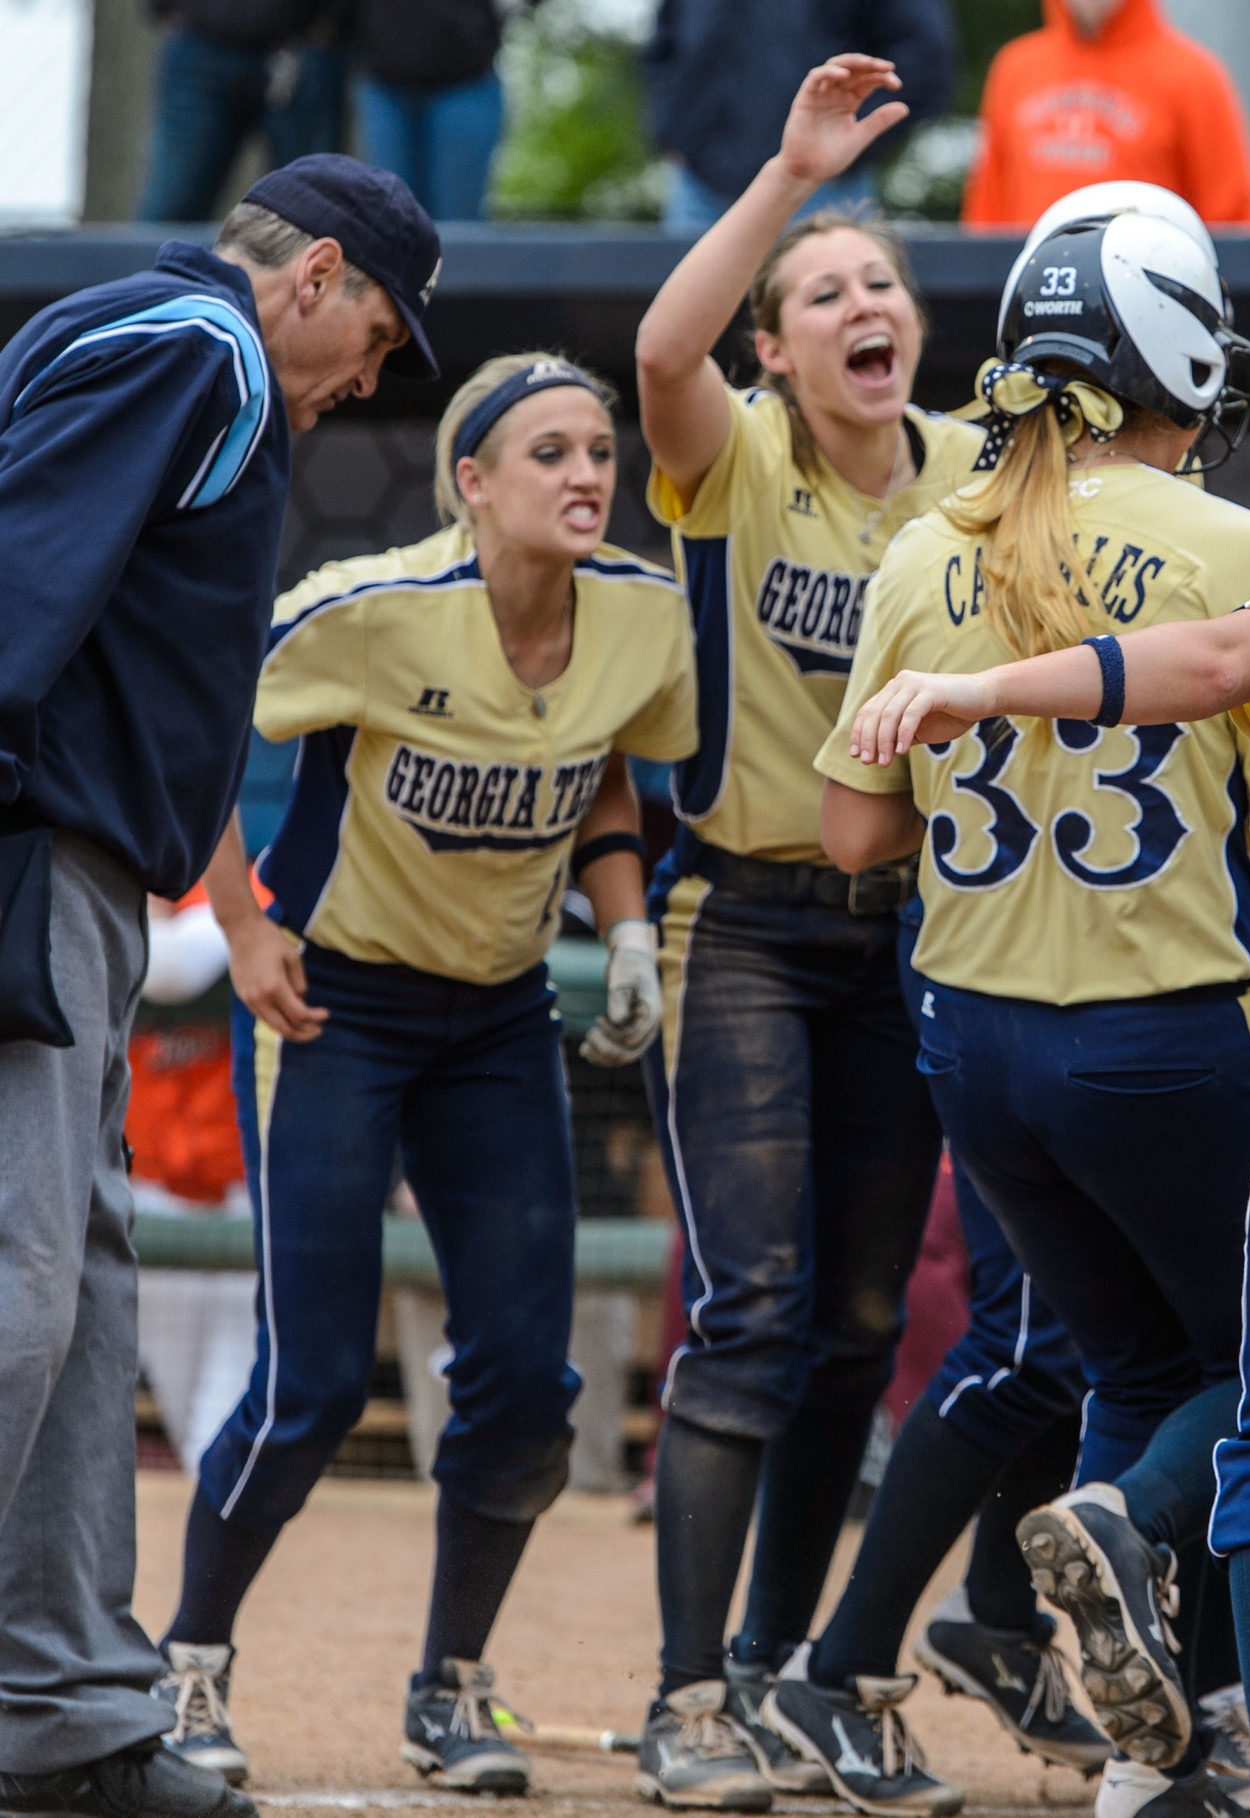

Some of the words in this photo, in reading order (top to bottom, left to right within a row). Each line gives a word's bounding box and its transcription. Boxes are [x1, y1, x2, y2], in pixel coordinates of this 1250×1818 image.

[1034, 300, 1083, 316] WORTH
[1040, 266, 1077, 296] 33
[386, 744, 544, 830] GEORGIA
[923, 713, 1195, 892] 33
